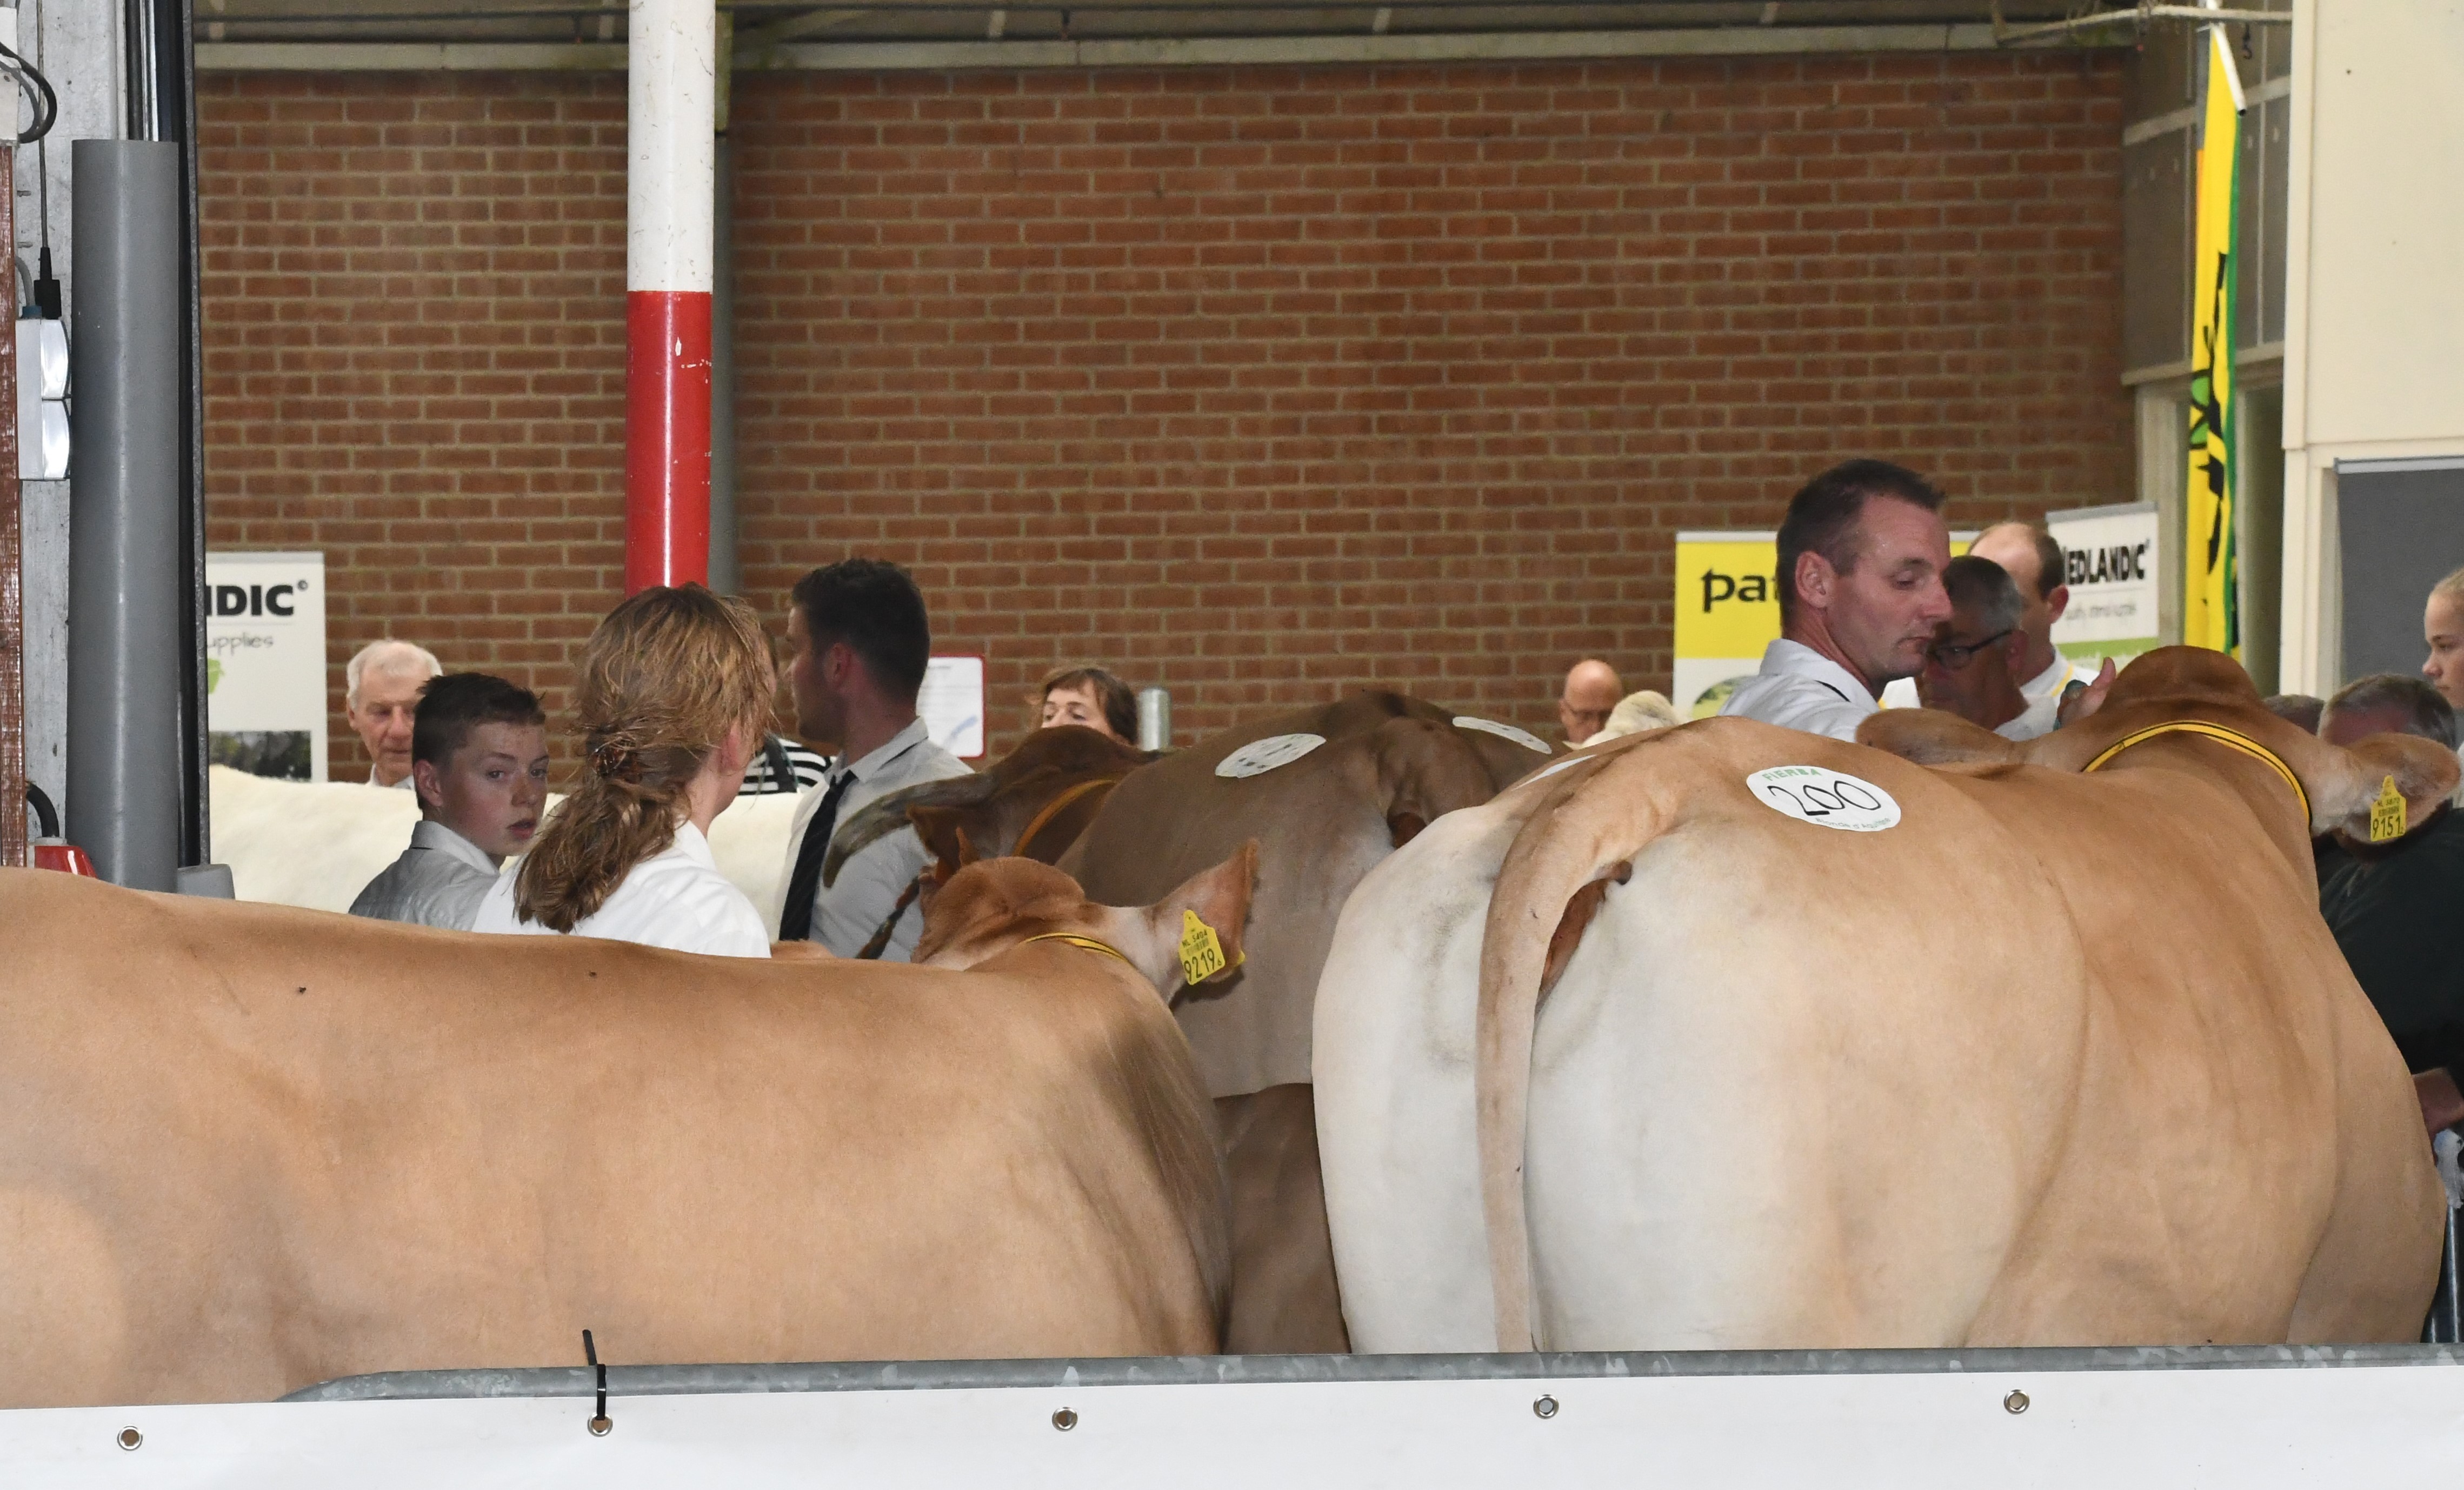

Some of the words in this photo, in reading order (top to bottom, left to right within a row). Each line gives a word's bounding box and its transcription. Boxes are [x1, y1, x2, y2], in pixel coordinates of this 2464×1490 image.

[2062, 543, 2146, 585] EDLANDIC
[206, 584, 294, 616] DIC
[1701, 568, 1779, 614] pa
[1767, 780, 1881, 816] 200
[2373, 815, 2401, 839] 9151
[1184, 948, 1215, 982] 9219
